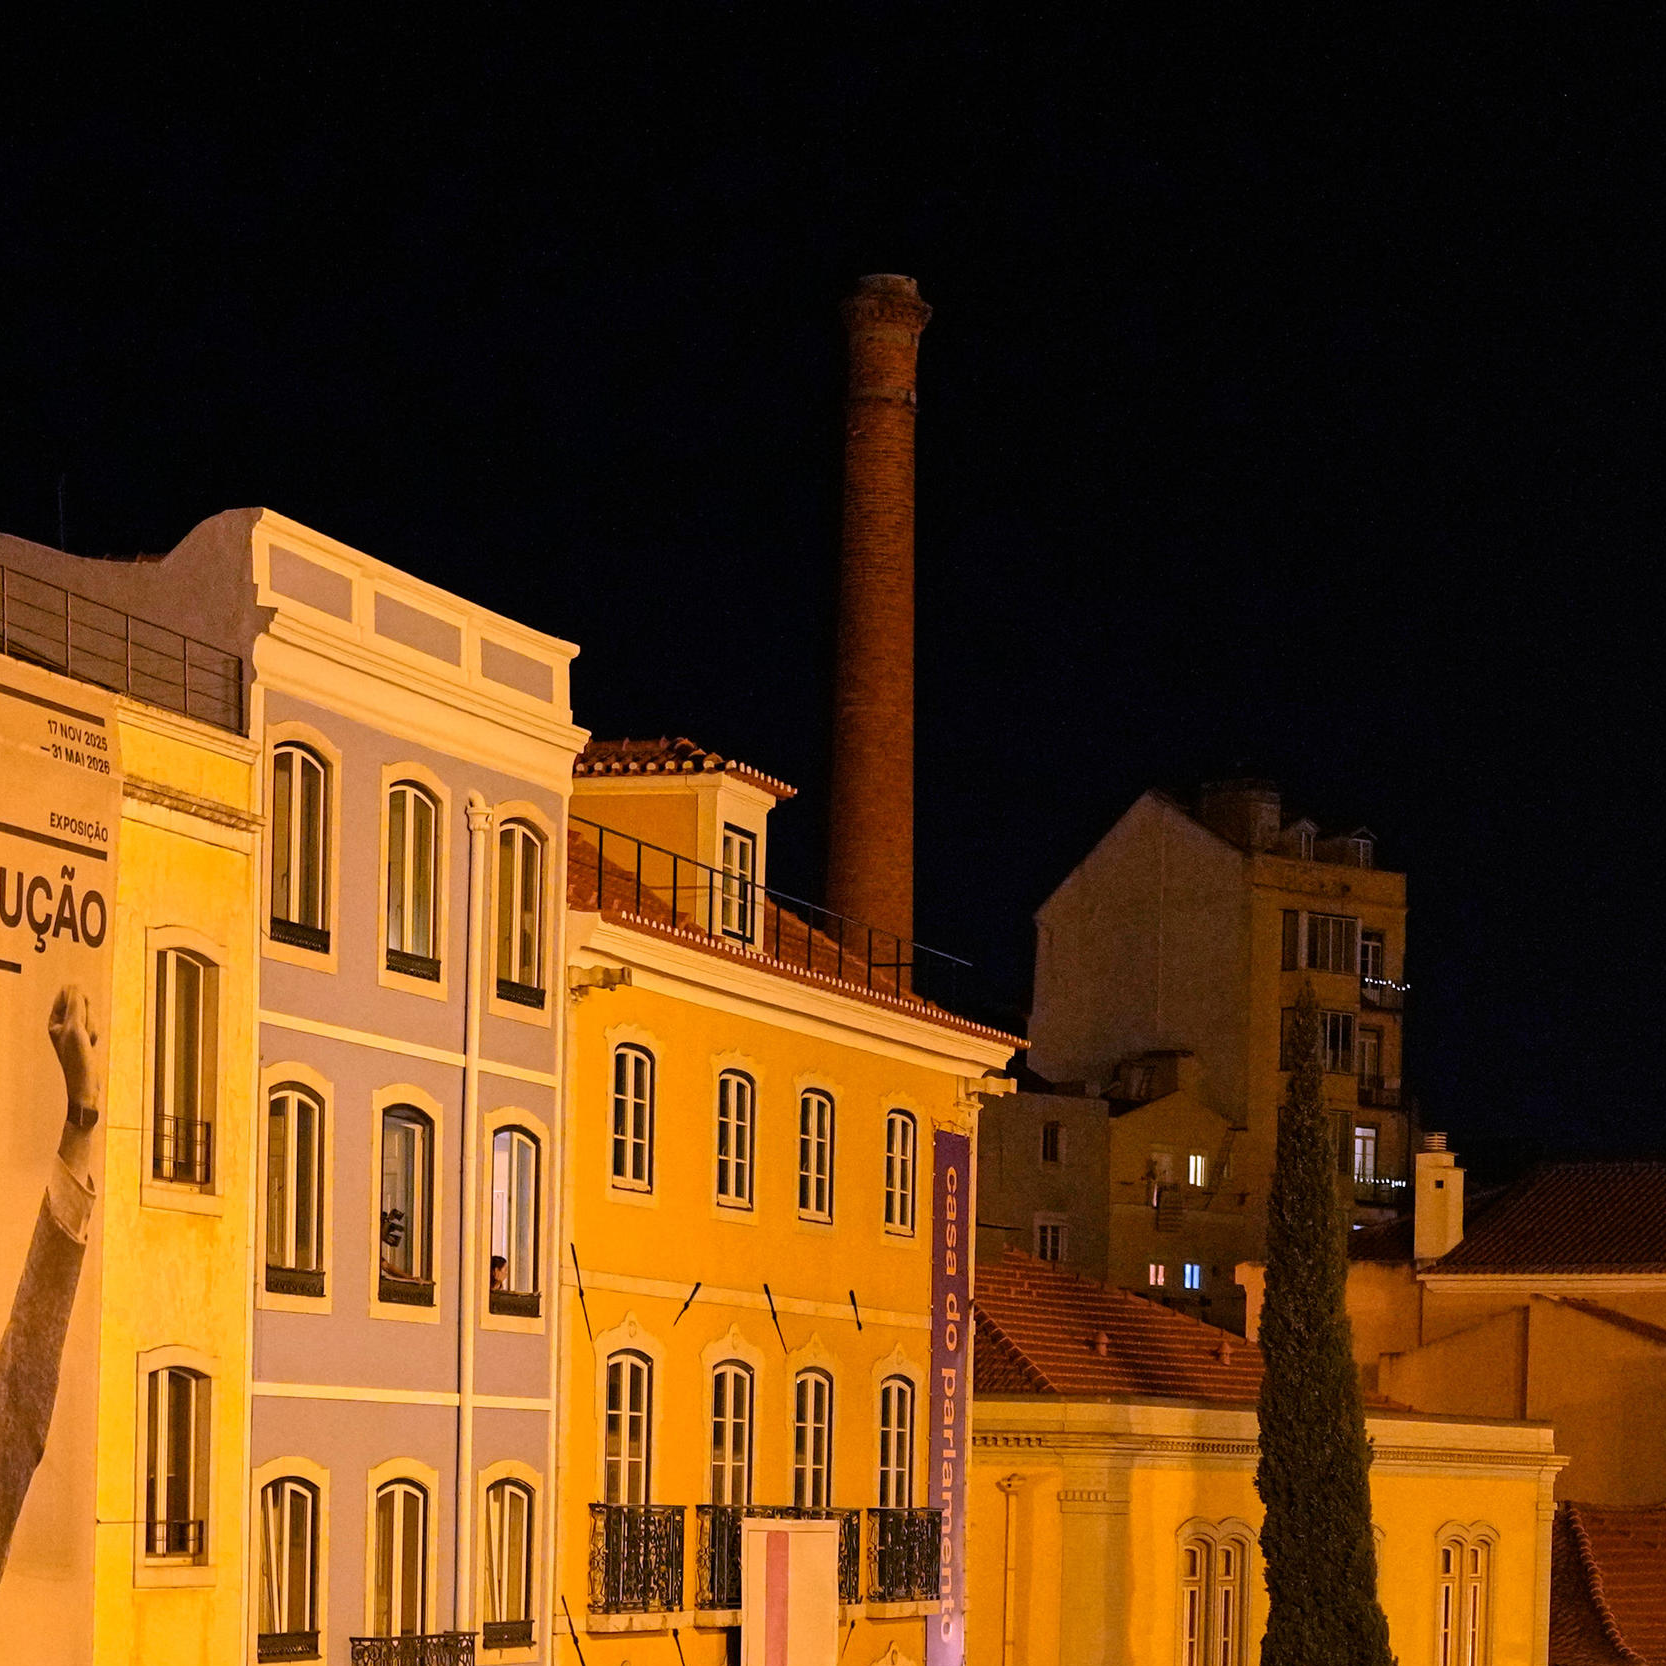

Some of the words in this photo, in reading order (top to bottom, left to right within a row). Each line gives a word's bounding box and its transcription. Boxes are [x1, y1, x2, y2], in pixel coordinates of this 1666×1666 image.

[47, 719, 59, 736] 17
[60, 725, 82, 745] NOV
[84, 732, 108, 751] 2025
[65, 751, 85, 768] MAI
[86, 757, 110, 776] 2026
[49, 811, 109, 844] EXPOSIÇÃO
[945, 1165, 958, 1276] casa
[945, 1292, 961, 1352] do
[940, 1366, 958, 1643] parlamento
